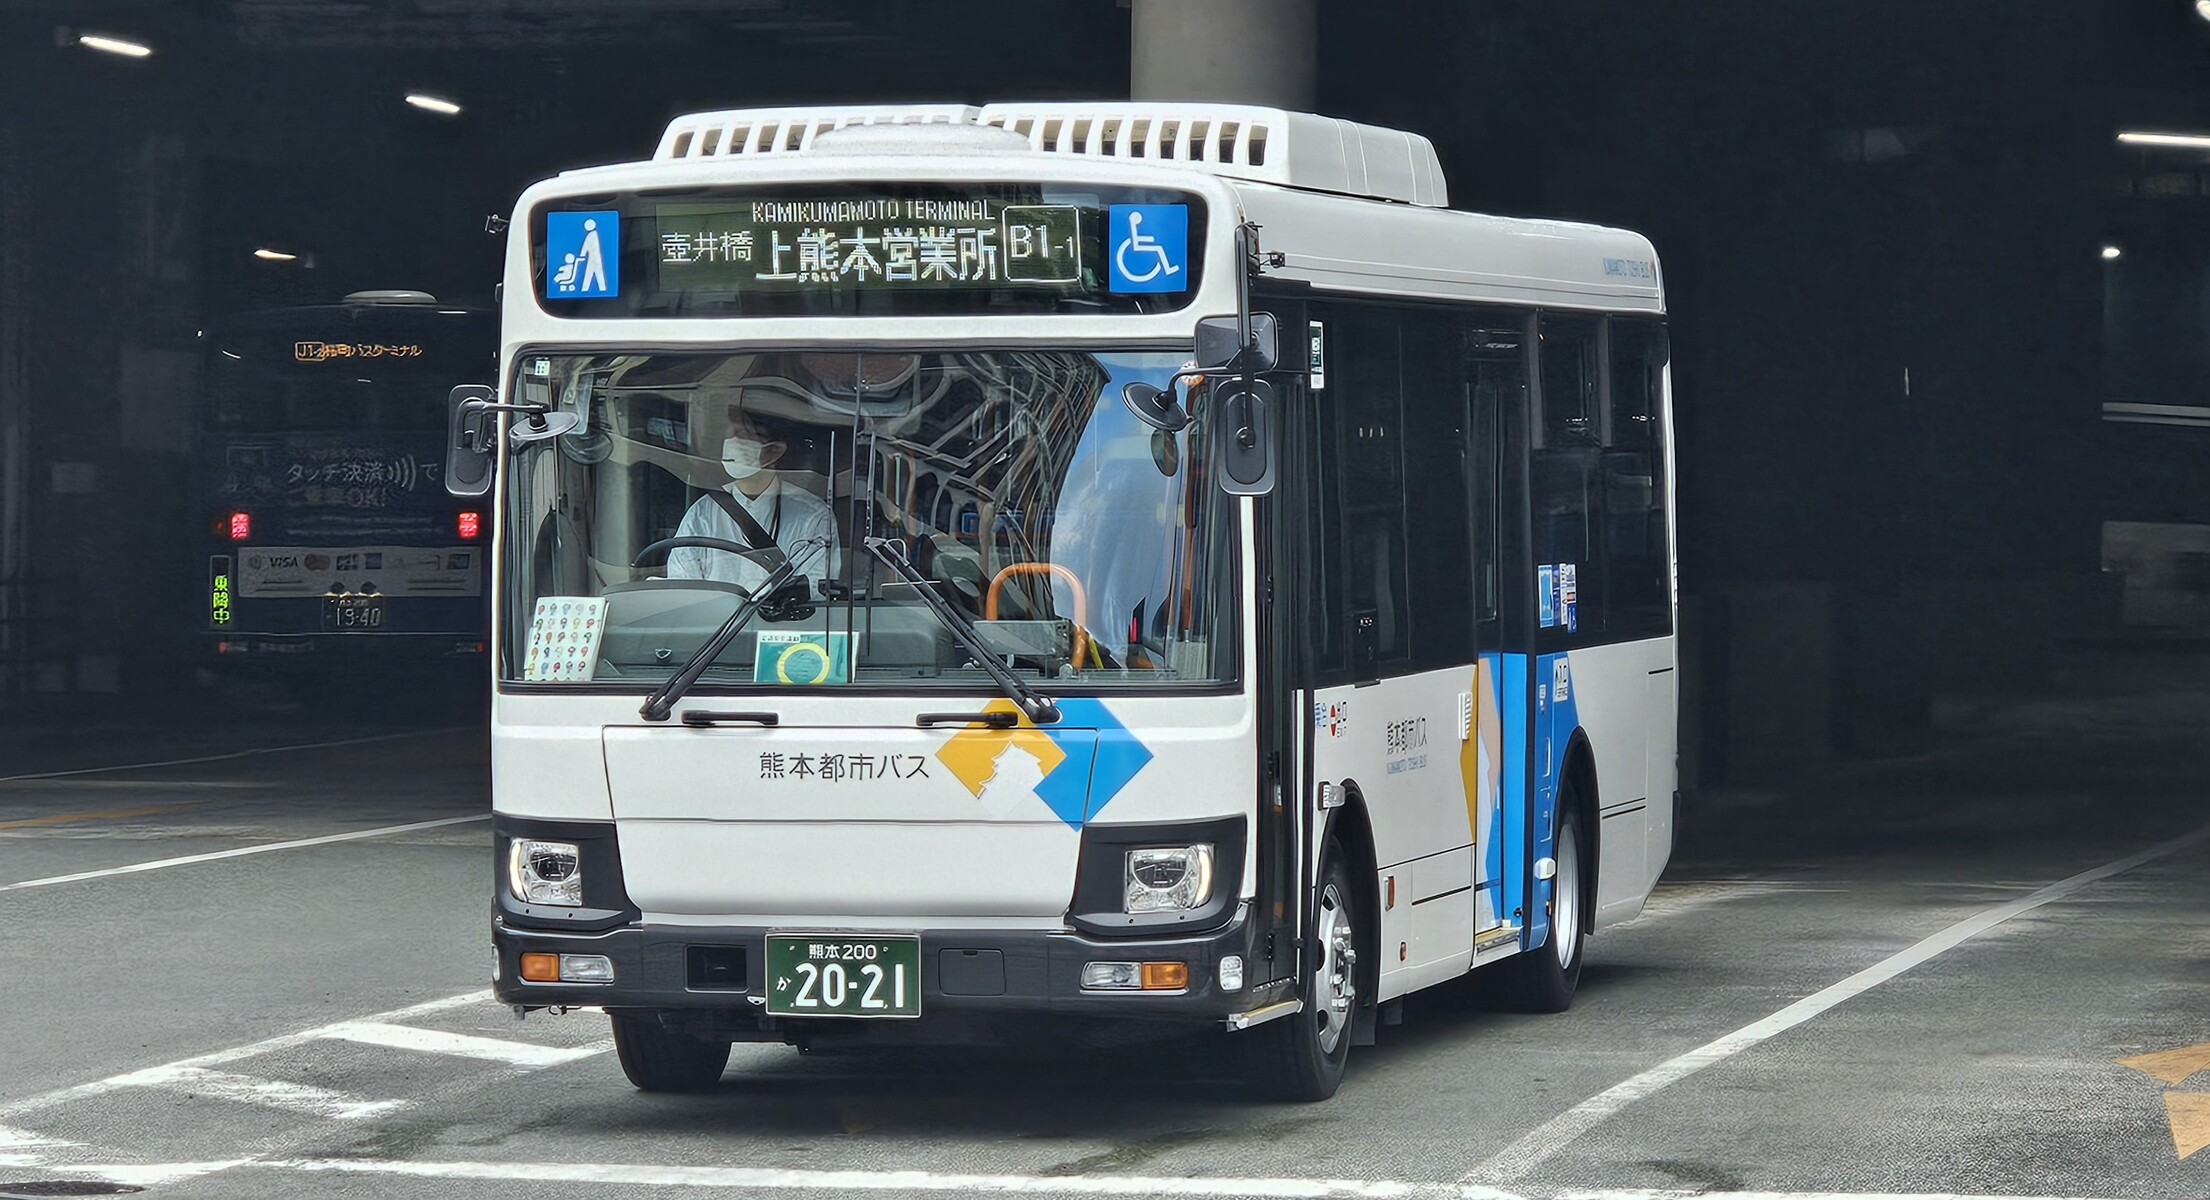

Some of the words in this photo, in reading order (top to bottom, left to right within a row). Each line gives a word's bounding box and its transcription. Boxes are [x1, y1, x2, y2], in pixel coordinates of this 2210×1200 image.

[752, 201, 899, 222] KAMIKUMAMOTO
[905, 199, 995, 221] TERMINAL
[755, 226, 997, 283] 上熊本営業所
[269, 556, 298, 568] VISA
[759, 752, 930, 782] 熊本都市バス
[776, 976, 791, 991] か
[795, 962, 904, 1008] 20-21
